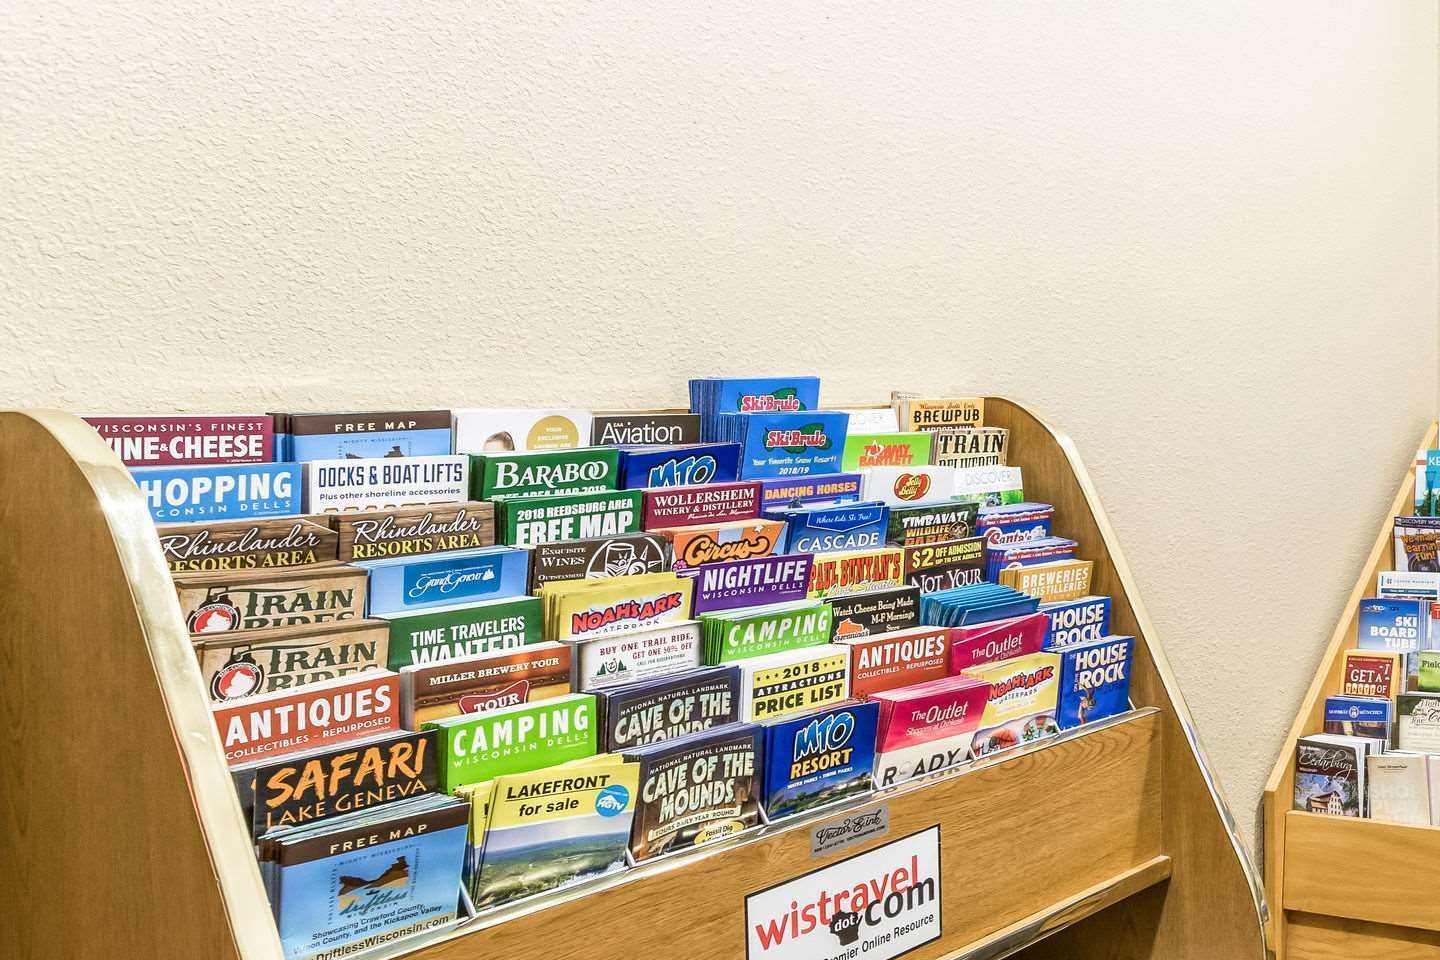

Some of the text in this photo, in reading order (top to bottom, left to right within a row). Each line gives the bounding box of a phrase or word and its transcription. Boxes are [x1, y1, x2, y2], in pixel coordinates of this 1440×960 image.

[335, 421, 418, 432] FREE MAP
[914, 409, 980, 424] BREWPUB
[600, 421, 682, 444] Aviation
[767, 430, 826, 447] Ski Brule
[939, 433, 1005, 454] TRAIN
[319, 465, 364, 488] DOCKS
[383, 464, 419, 485] BOAT
[423, 463, 463, 483] LIFTS
[493, 461, 609, 489] BARABOO
[655, 488, 754, 507] WOLLERSHEIM
[764, 482, 857, 500] DANCING HORSES
[517, 498, 633, 521] 2018 REEDSBURG AREA
[654, 506, 692, 516] WINERY
[702, 500, 754, 512] DISTILLERY
[351, 509, 481, 543] Rhinelander
[516, 511, 633, 545] FREE MAP
[906, 524, 950, 537] WILDLIFE
[352, 533, 481, 560] RESORTS AREA
[685, 535, 769, 565] Circus
[797, 532, 879, 552] CASCADE
[912, 549, 934, 568] $2
[935, 547, 948, 558] OFF
[703, 560, 807, 592] NIGHTLIFE
[809, 553, 900, 591] PAUL BUNYAN'S
[1022, 567, 1089, 588] BREWERIES
[411, 616, 525, 647] TIME TRAVELERS
[1370, 626, 1418, 637] BOARD
[1395, 616, 1418, 627] SKI
[600, 632, 693, 656] BUY ONE TRAIL RIDE.
[1383, 636, 1418, 649] TUBE
[268, 639, 376, 674] TRAIN
[782, 661, 821, 679] 2018
[1075, 646, 1128, 671] HOUSE
[429, 656, 560, 686] MILLER BREWERY TOUR
[757, 671, 841, 696] ATTRACTIONS
[1079, 664, 1126, 691] ROCK
[1351, 669, 1375, 682] GET
[754, 684, 842, 717] PRICE LIST
[225, 684, 391, 747] ANTIQUES
[454, 704, 589, 758] CAMPING
[794, 712, 854, 762] MTO
[454, 730, 590, 768] WISCONSIN DELLS
[650, 744, 751, 775] NATIONAL NATURAL LANDMARK
[266, 739, 428, 808] SAFARI
[643, 763, 688, 803] CAVE
[692, 756, 718, 784] OF
[723, 752, 754, 777] THE
[790, 749, 853, 780] RESORT
[506, 774, 610, 799] LAKEFRONT
[266, 780, 427, 828] LAKE GENEVA
[519, 798, 579, 817] for sale
[659, 778, 735, 823] MOUNDS
[330, 823, 429, 854] FREE MAP
[755, 855, 920, 951] wistravel
[865, 877, 935, 926] com
[862, 932, 891, 952] Online
[893, 913, 934, 938] Resource
